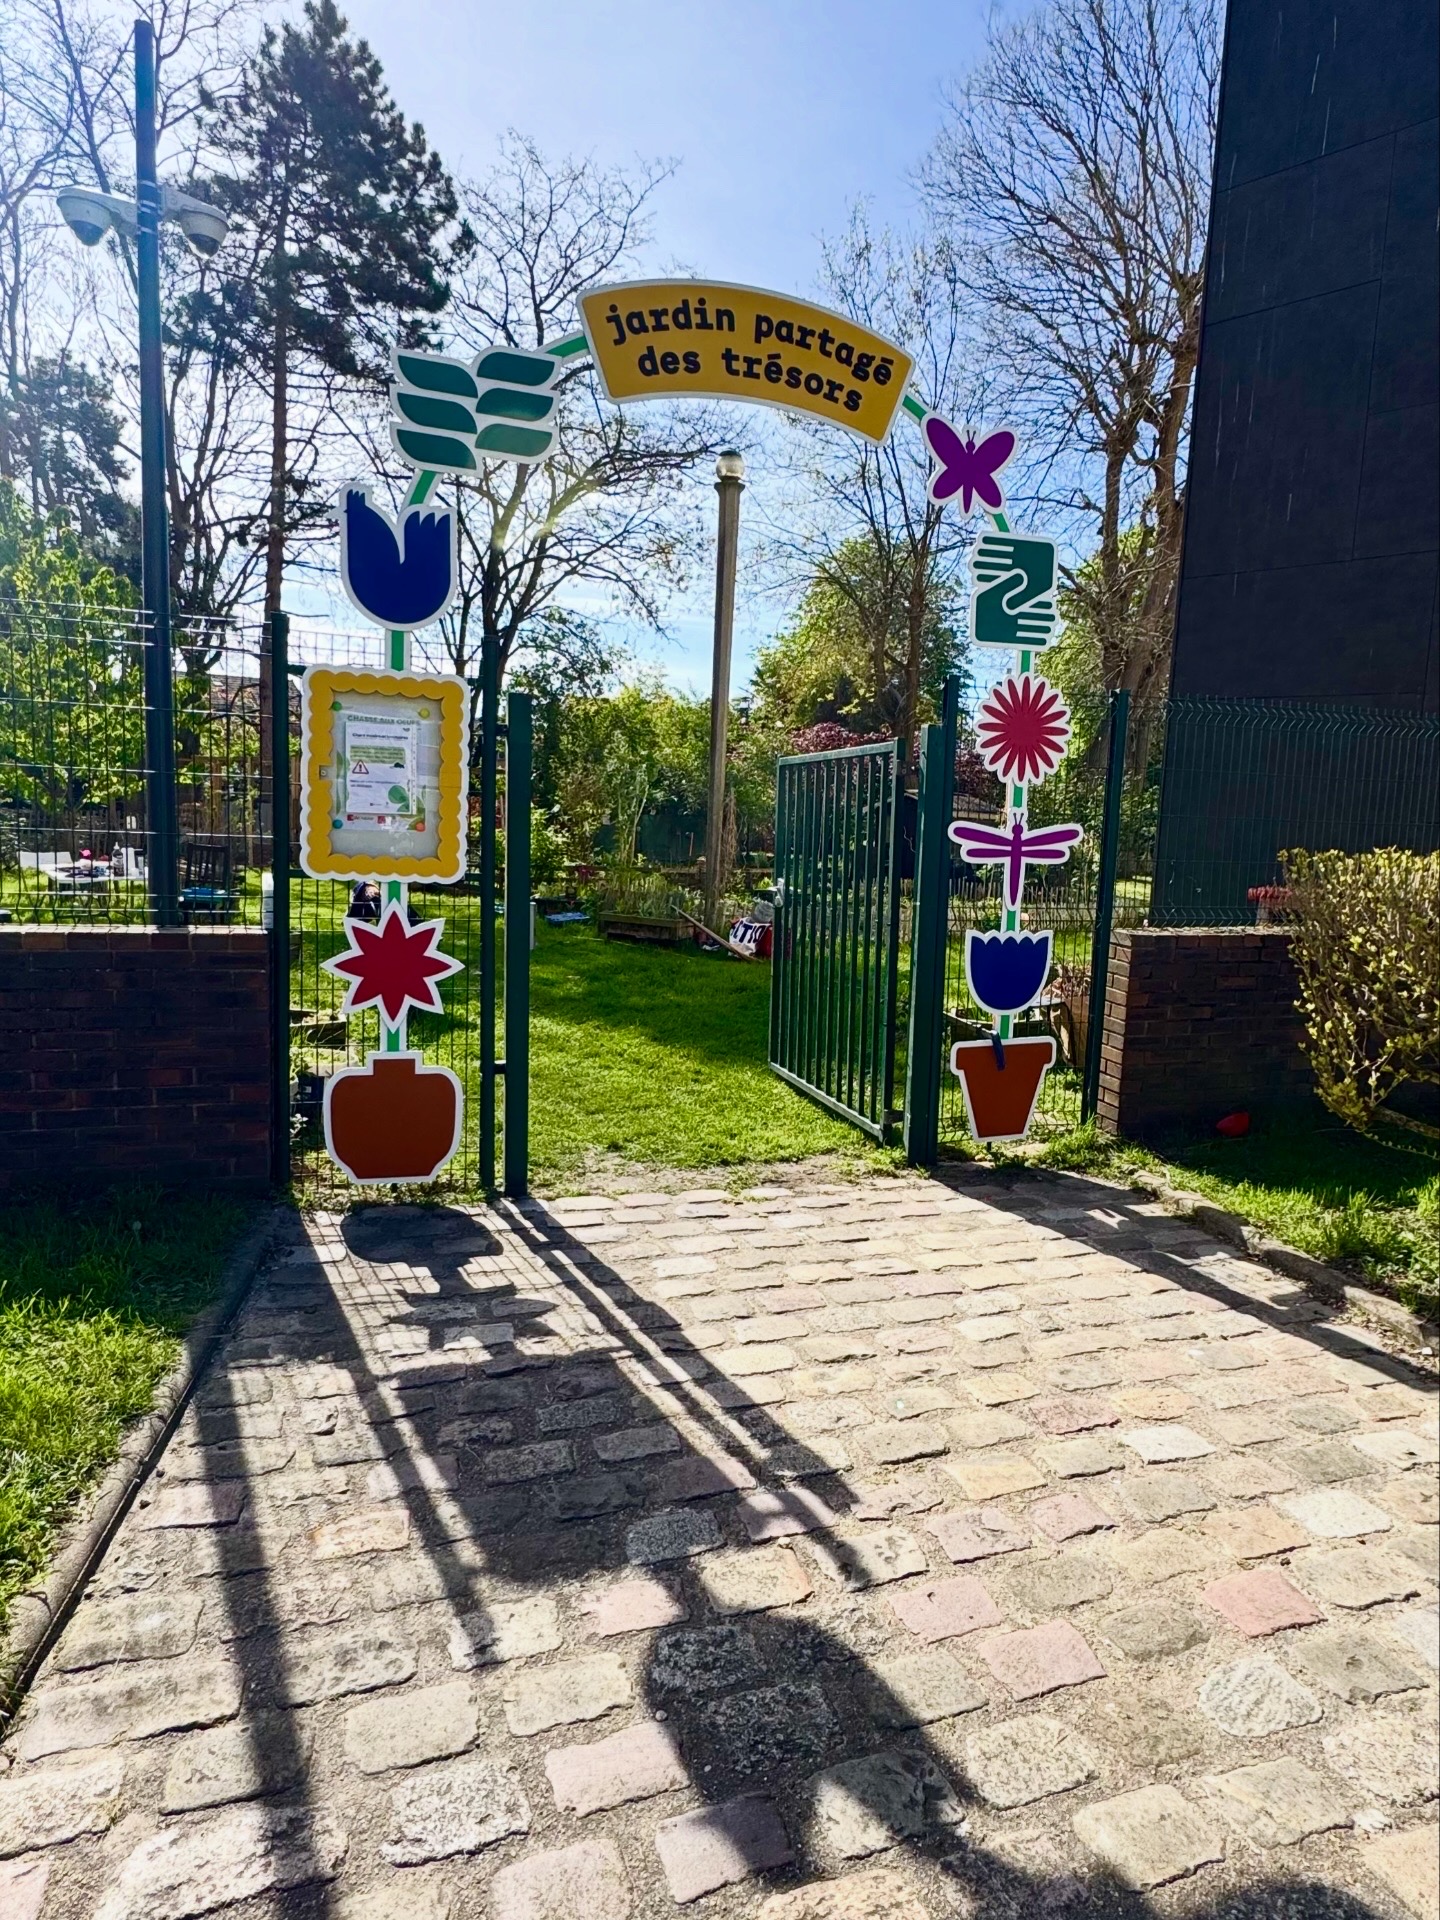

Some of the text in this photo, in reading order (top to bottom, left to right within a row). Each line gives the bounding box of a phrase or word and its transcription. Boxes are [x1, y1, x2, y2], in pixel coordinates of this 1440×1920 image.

[606, 297, 895, 386] jardin partagé
[637, 346, 863, 412] des trésors
